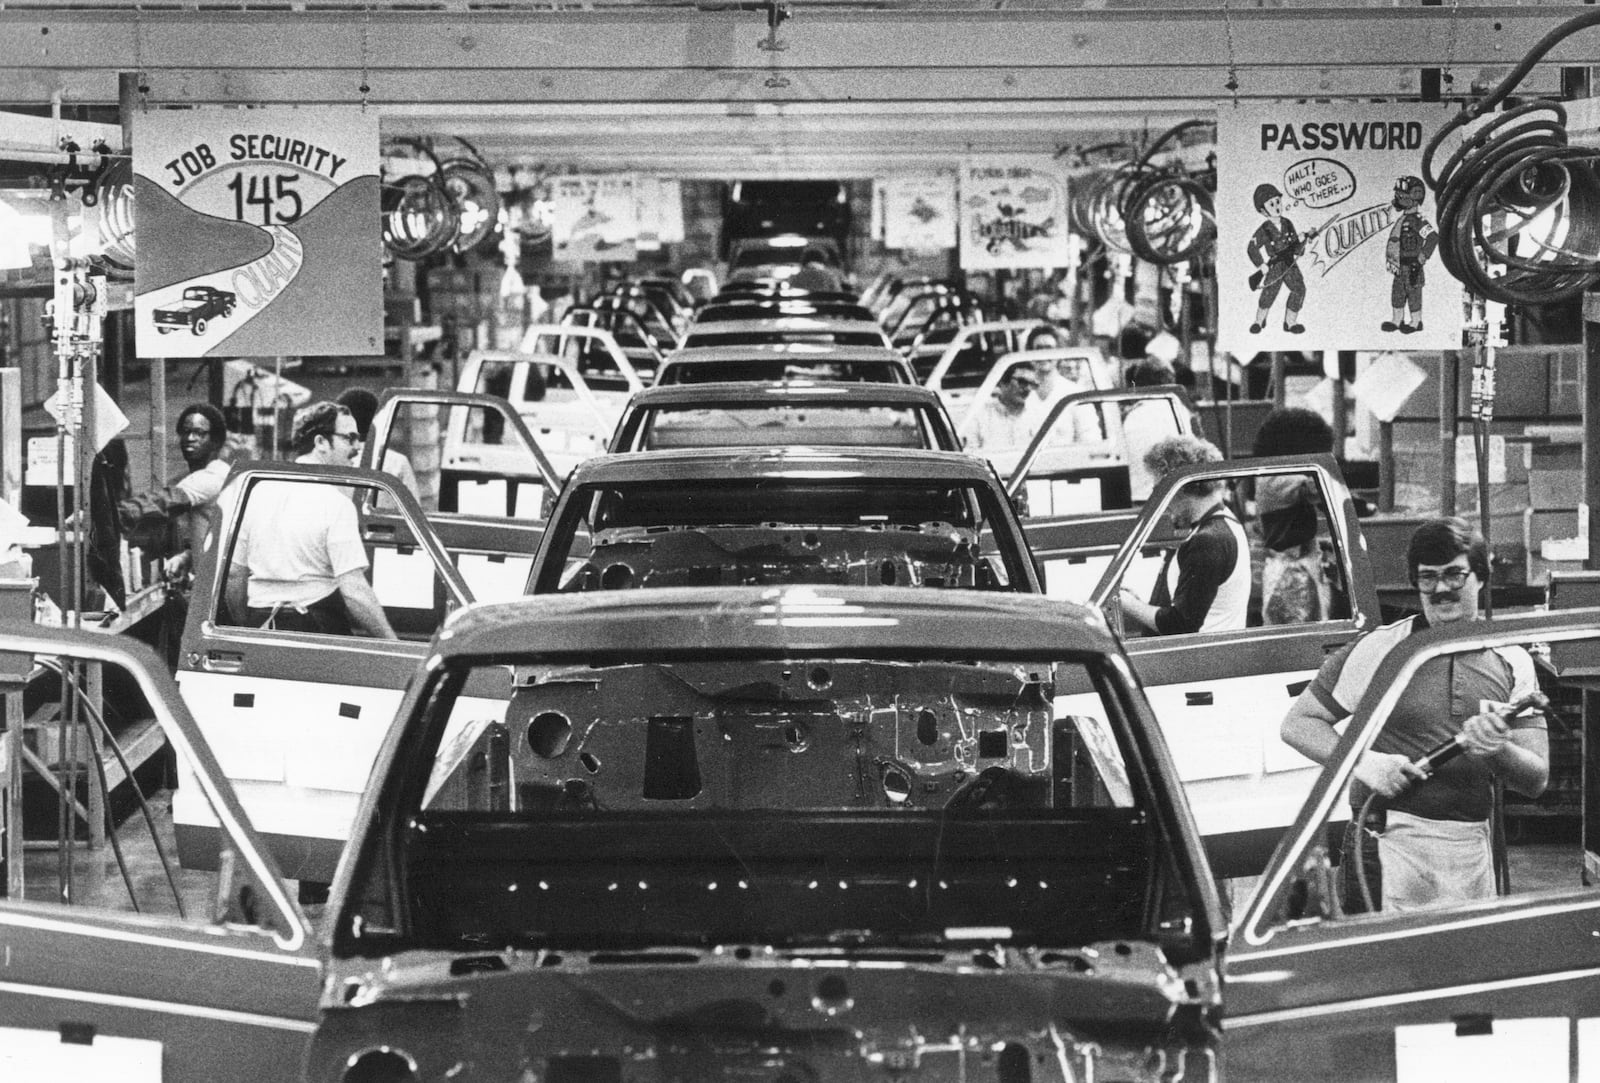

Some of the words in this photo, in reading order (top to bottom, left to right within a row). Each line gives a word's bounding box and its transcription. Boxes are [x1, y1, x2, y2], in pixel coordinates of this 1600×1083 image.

[1261, 121, 1422, 150] PASSWORD
[165, 143, 216, 186] JOB
[230, 134, 346, 178] SECURITY
[1289, 161, 1316, 184] HALT!
[228, 172, 302, 225] 145
[1293, 181, 1312, 196] WHO
[1315, 171, 1337, 187] GOES
[1309, 184, 1351, 202] THERE...
[1325, 205, 1392, 258] QUALITY
[232, 225, 301, 309] QUALITY
